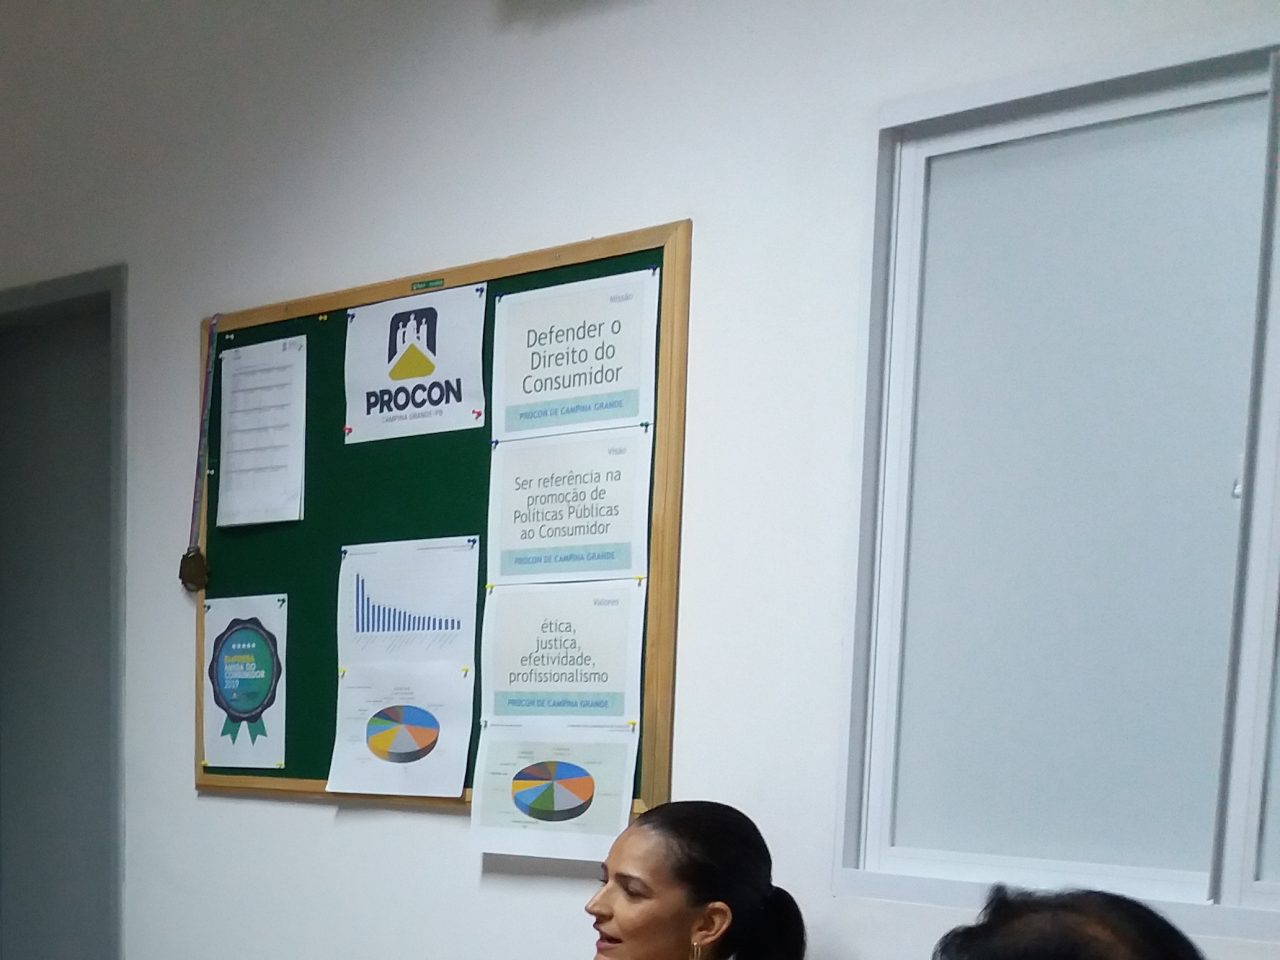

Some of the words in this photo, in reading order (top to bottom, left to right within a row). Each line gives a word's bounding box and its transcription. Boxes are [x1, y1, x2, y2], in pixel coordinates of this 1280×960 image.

[527, 320, 604, 348] Defender
[611, 319, 621, 335] o
[531, 347, 588, 371] Direito
[595, 341, 615, 361] do
[522, 364, 623, 394] Consumidor
[365, 378, 462, 415] PROCON
[514, 476, 534, 491] Ser
[538, 469, 600, 488] referência
[606, 470, 621, 482] na
[527, 488, 587, 508] promoção
[591, 486, 606, 501] de
[513, 508, 563, 524] Políticas
[568, 503, 619, 520] Públicas
[520, 528, 535, 540] ao
[539, 521, 611, 539] Consumidor
[541, 618, 576, 635] ética,
[535, 636, 581, 653] justiça,
[520, 651, 596, 667] efetividade,
[509, 668, 608, 685] profissionalismo
